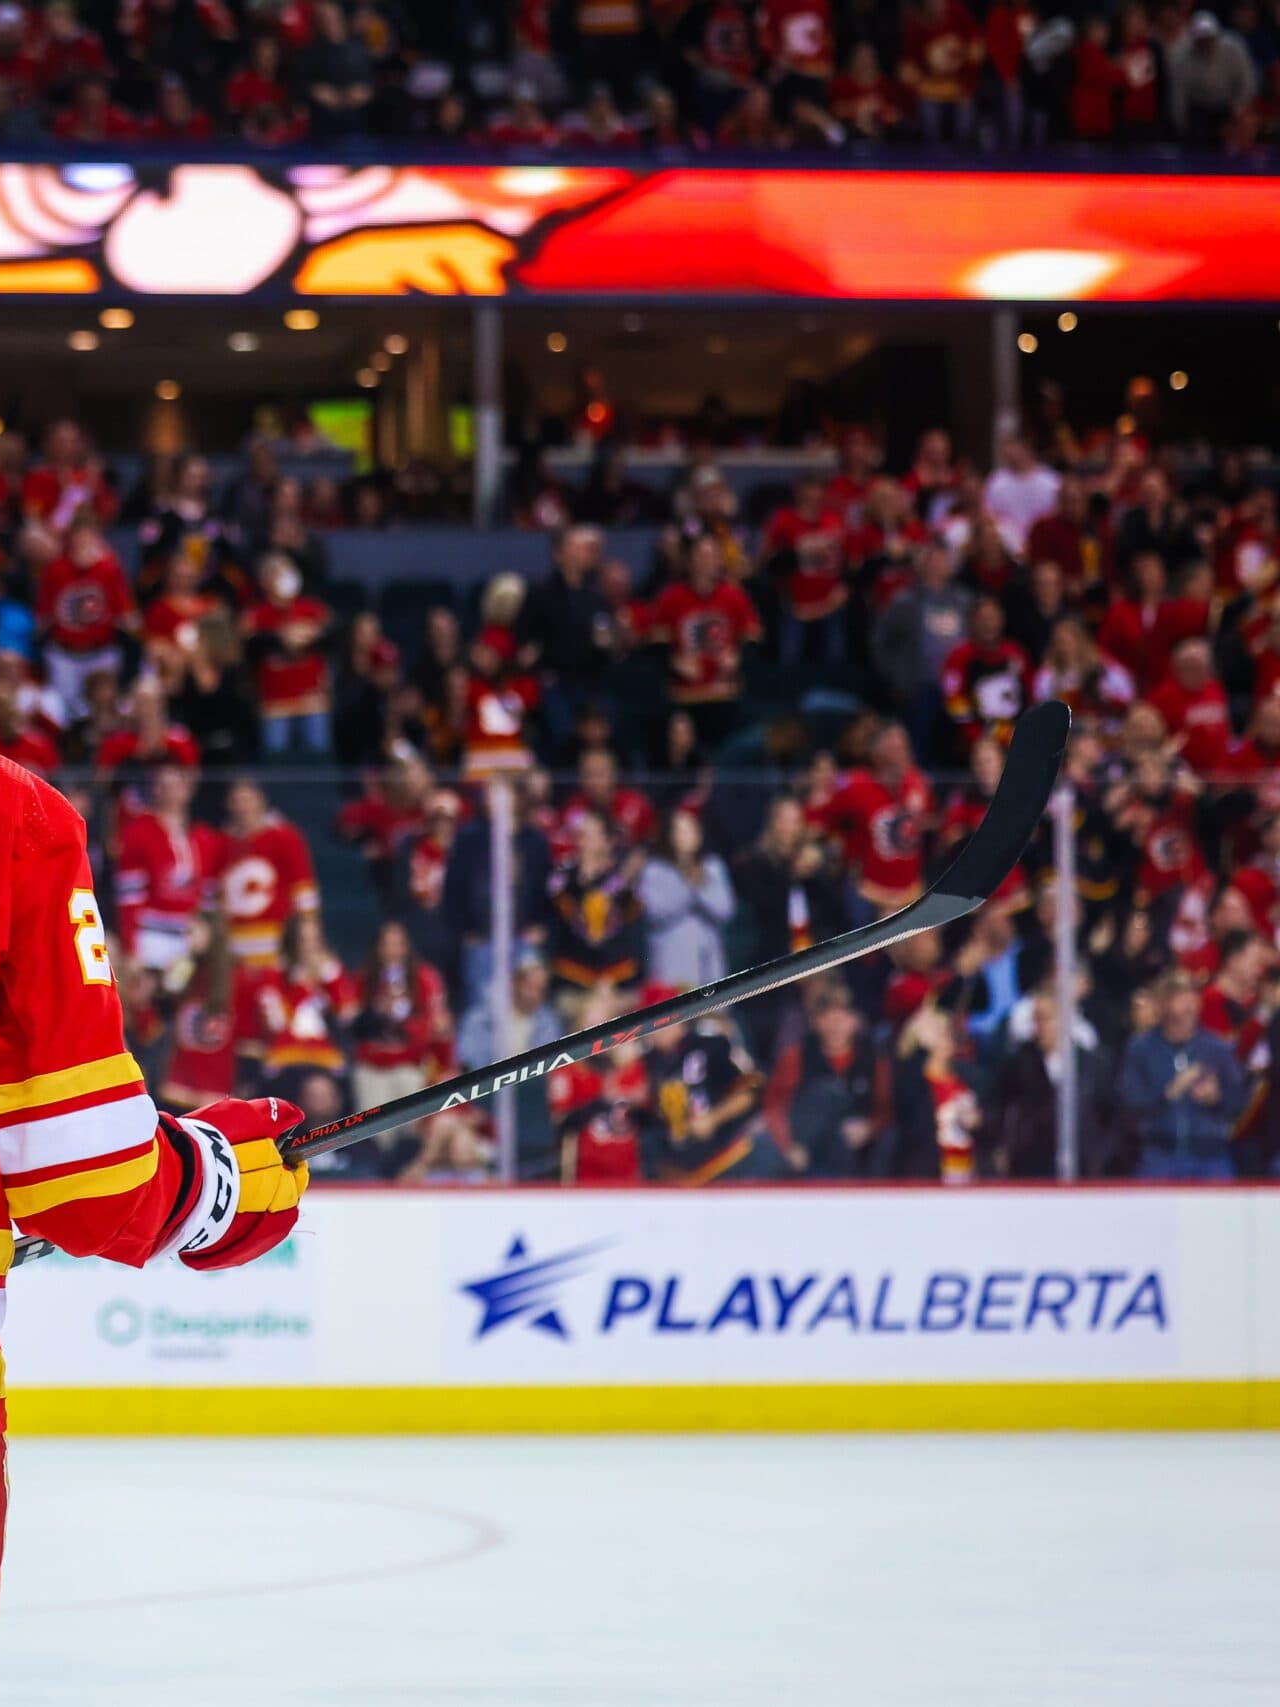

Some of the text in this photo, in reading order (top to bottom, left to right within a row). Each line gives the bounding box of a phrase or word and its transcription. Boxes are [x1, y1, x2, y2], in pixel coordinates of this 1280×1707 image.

[440, 1052, 575, 1111] ALPHA
[291, 1122, 340, 1148] ALPHA
[344, 1113, 365, 1128] LX
